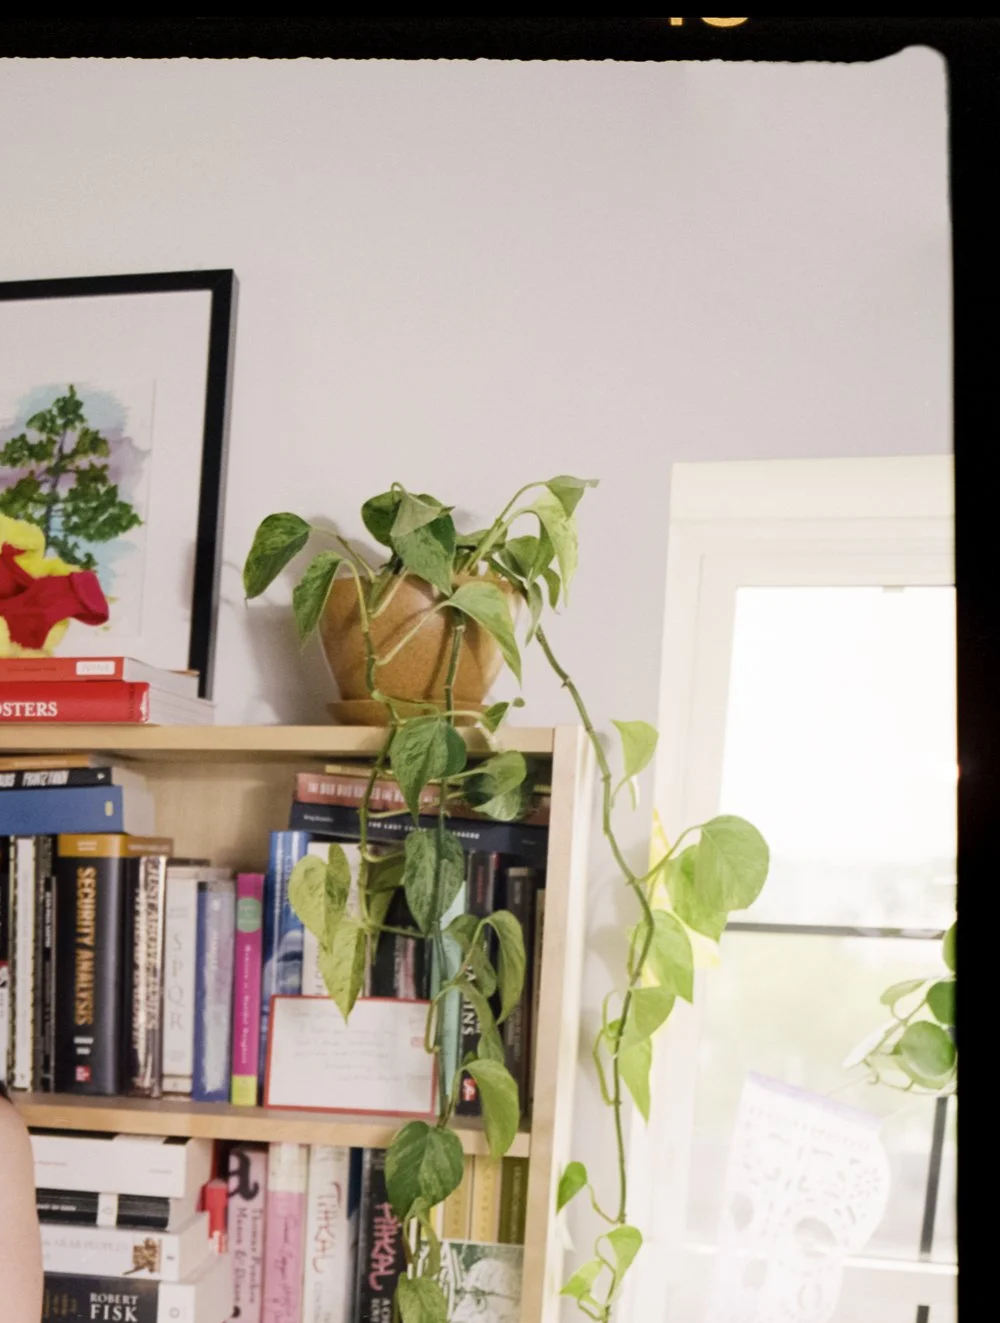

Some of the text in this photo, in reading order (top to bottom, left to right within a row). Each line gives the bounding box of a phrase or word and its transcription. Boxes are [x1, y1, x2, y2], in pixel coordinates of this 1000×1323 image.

[73, 867, 97, 1026] SECURITY ANALYSIS
[235, 1207, 248, 1245] Mason
[248, 1208, 263, 1304] Thomas Pynchon
[90, 1292, 140, 1306] ROBERT
[233, 1267, 246, 1307] Dixon
[380, 1298, 391, 1306] A
[90, 1304, 139, 1323] FISK
